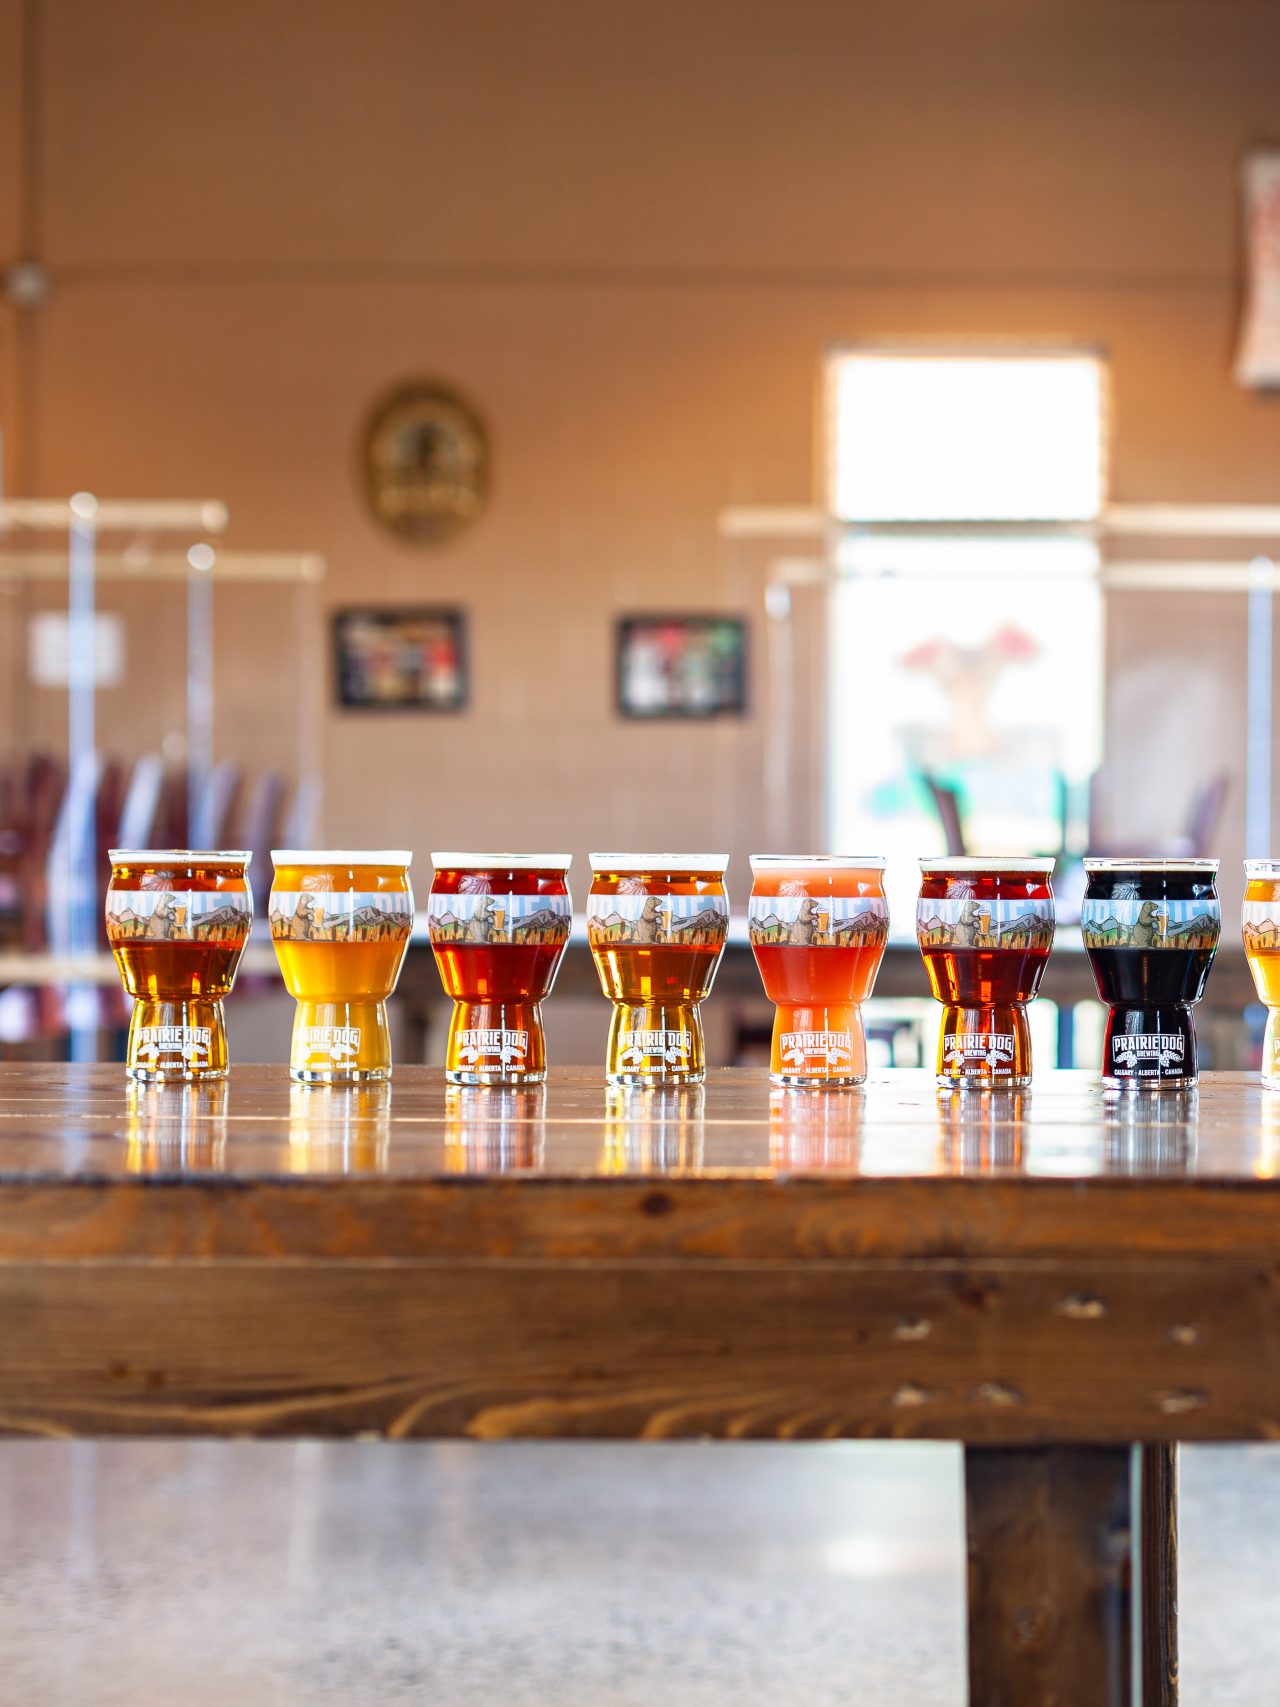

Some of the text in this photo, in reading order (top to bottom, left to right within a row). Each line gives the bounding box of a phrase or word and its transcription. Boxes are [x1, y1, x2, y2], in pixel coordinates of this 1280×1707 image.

[138, 1028, 209, 1048] PRAIRIE DOG
[333, 1029, 359, 1047] DOG
[457, 1032, 525, 1049] PRAIRIE DOG
[619, 1033, 689, 1050] PRAIRIE DOG
[782, 1034, 851, 1051] PRAIRIE DOG
[945, 1035, 1012, 1053] PRAIRIE DOG
[1115, 1036, 1183, 1053] PRAIRIE DOG
